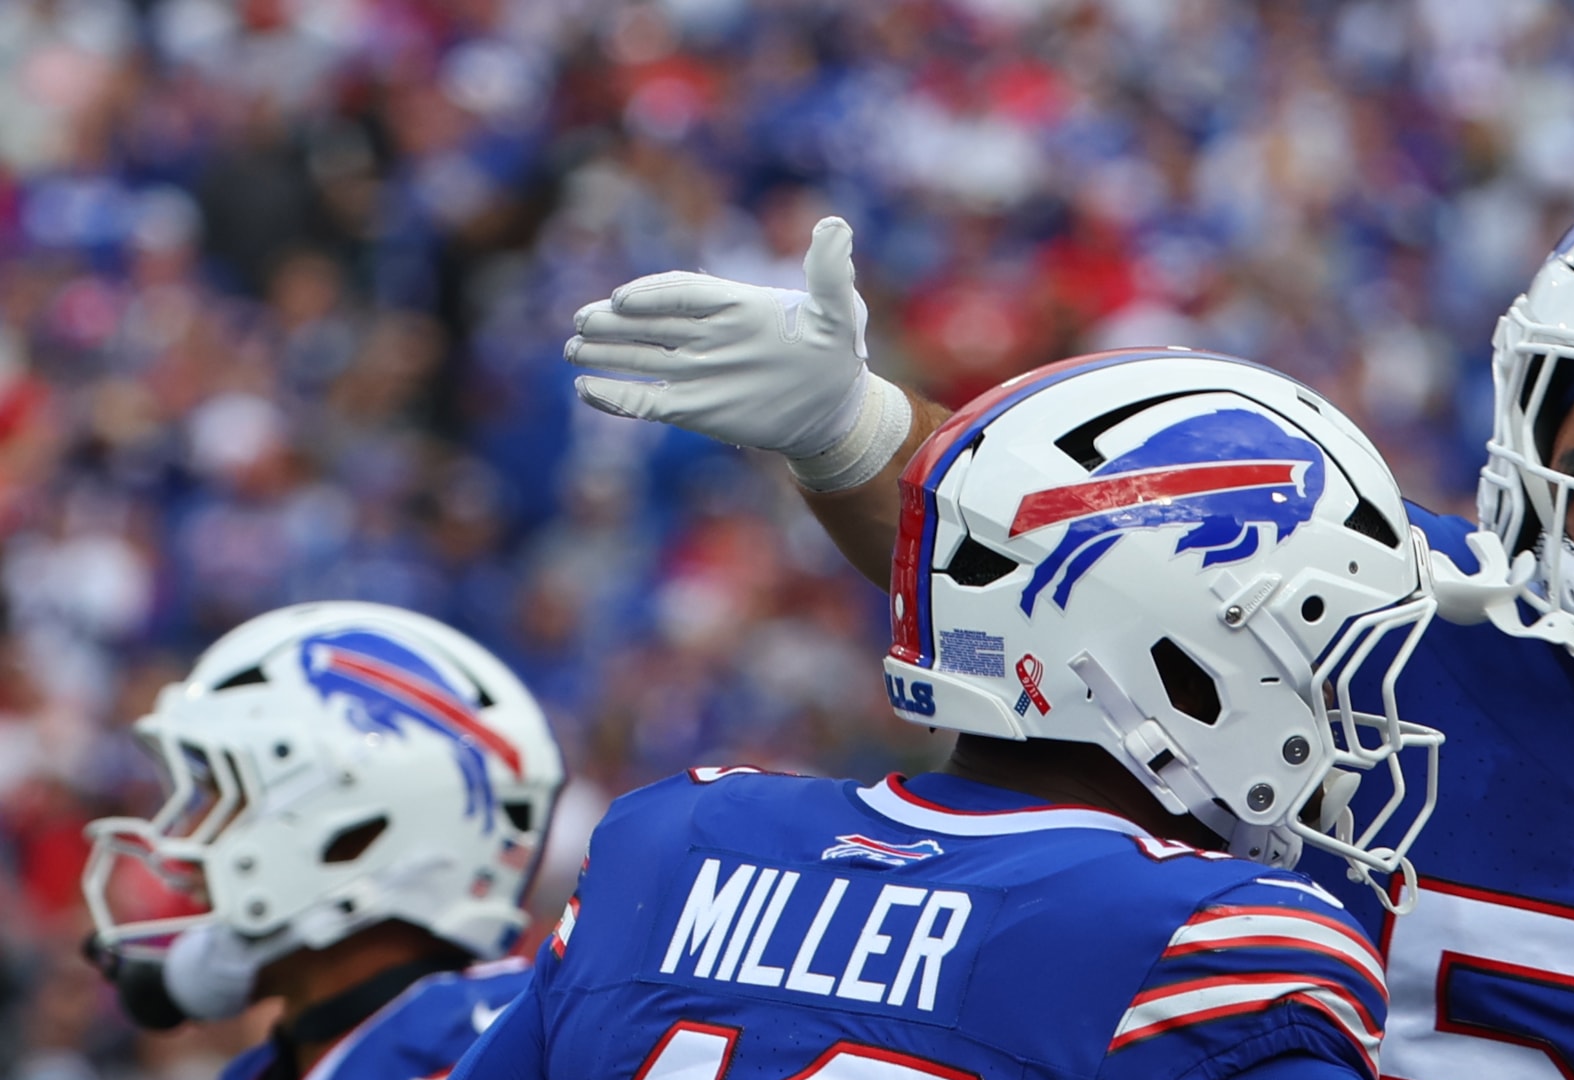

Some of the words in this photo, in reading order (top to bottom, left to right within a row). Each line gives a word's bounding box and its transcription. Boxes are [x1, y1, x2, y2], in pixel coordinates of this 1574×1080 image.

[884, 672, 936, 717] LLS
[1022, 677, 1039, 699] 9/11
[659, 858, 972, 1012] MILLER
